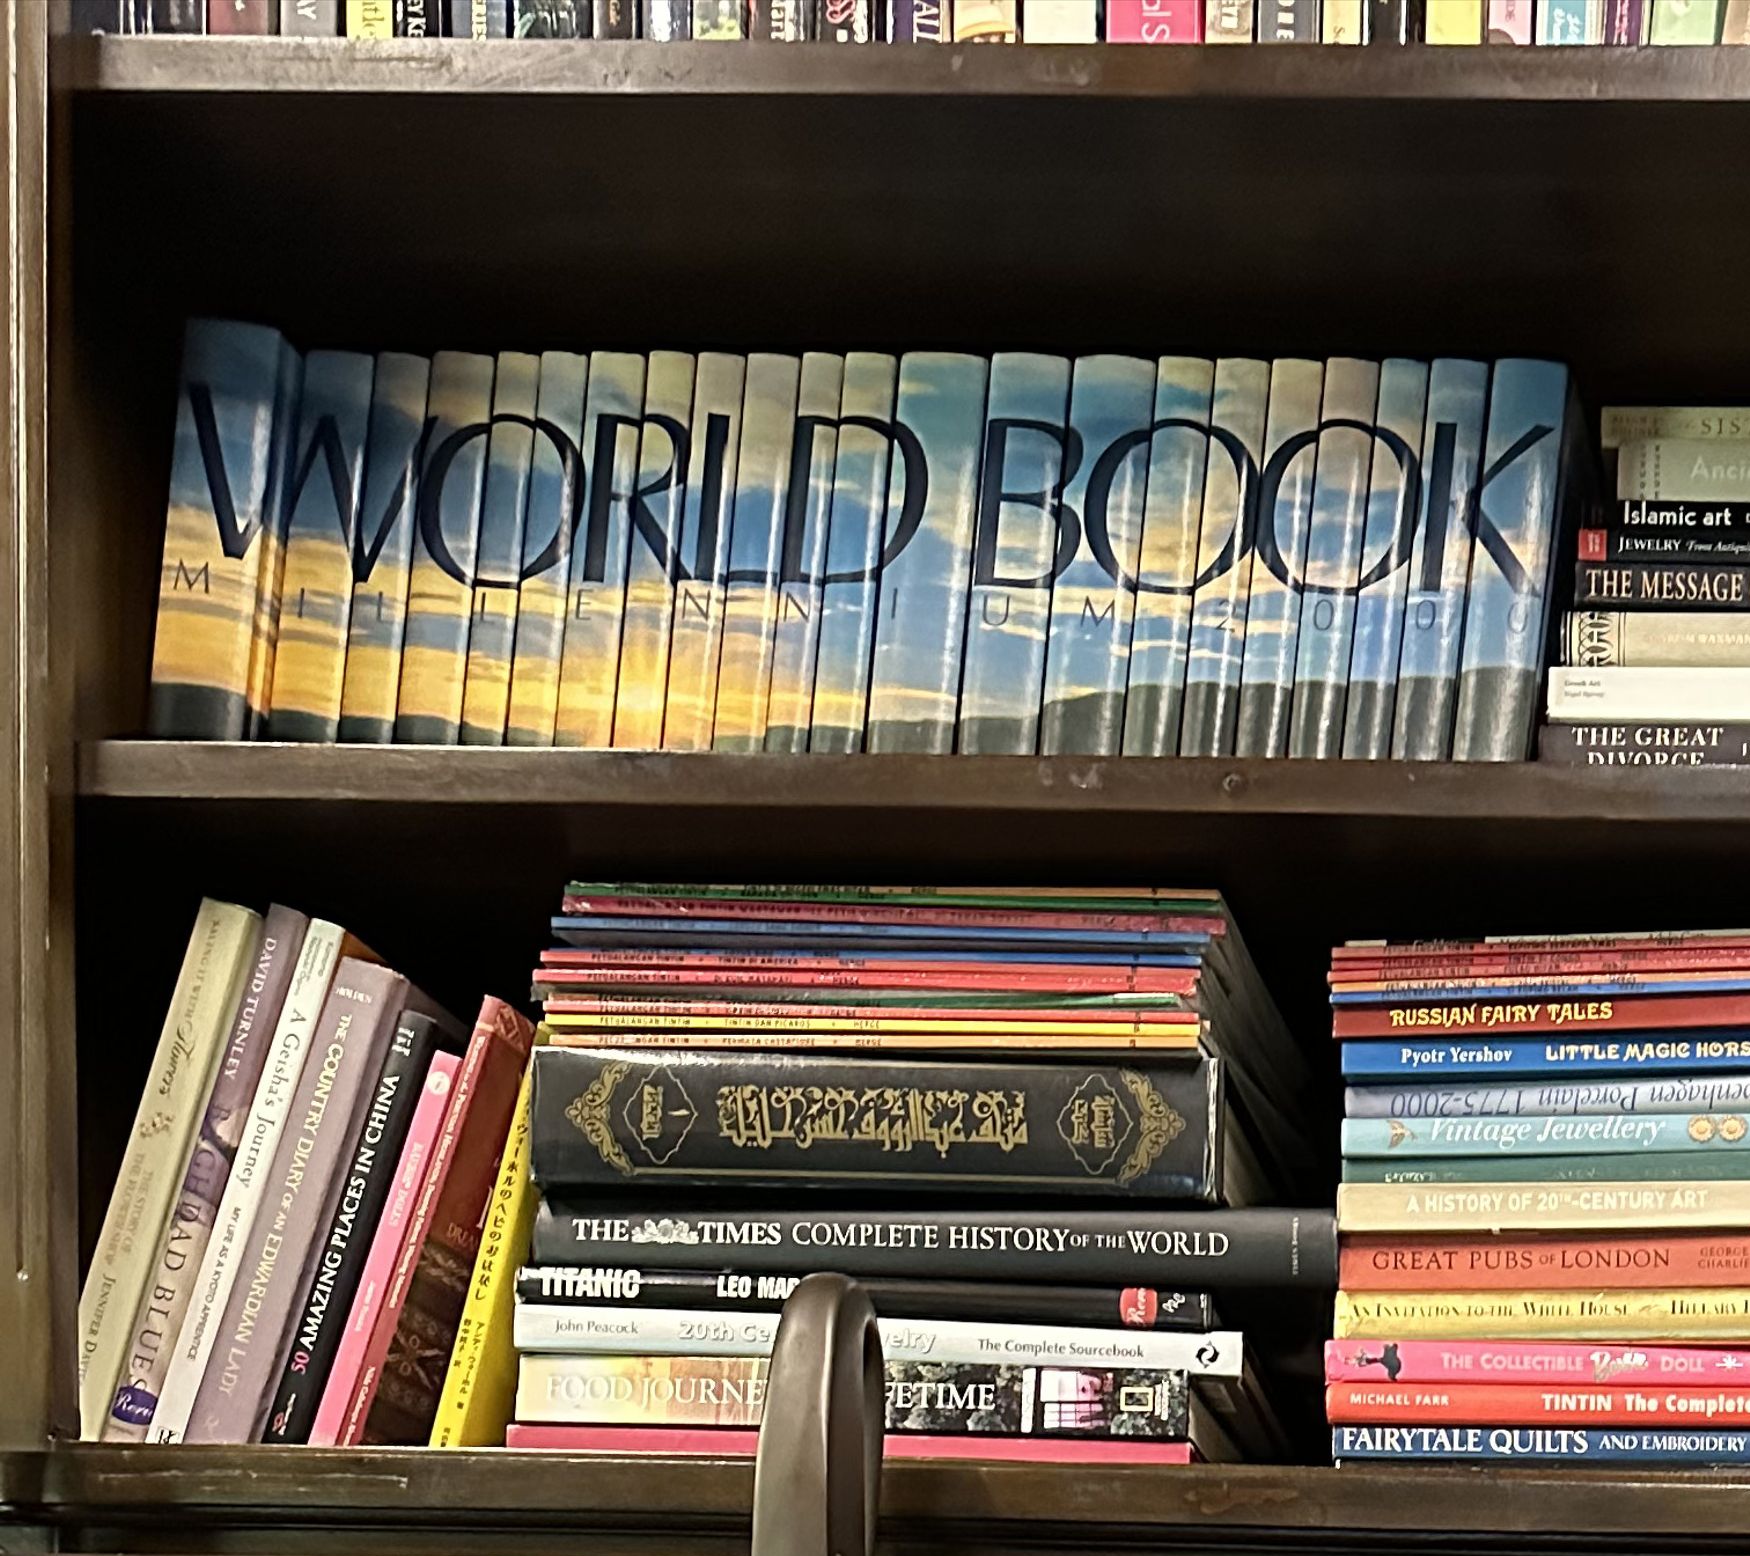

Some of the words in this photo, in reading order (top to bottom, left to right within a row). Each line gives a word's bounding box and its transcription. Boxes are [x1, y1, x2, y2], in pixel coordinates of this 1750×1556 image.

[190, 383, 929, 588] WORLD
[973, 416, 1555, 599] BOOK
[1624, 502, 1696, 527] Islamic
[1703, 508, 1731, 527] art
[1586, 569, 1633, 598] THE
[1641, 572, 1743, 602] MESSAGE
[1390, 1005, 1476, 1028] RUSSIAN
[1481, 1004, 1539, 1025] FAIRY
[1547, 1001, 1613, 1022] TALES
[363, 1073, 402, 1147] CHINA
[356, 1150, 372, 1173] IN
[330, 1176, 363, 1257] PLACES
[573, 1219, 629, 1243] THE
[698, 1219, 782, 1246] TIMES
[792, 1222, 939, 1250] COMPLETE
[949, 1225, 1070, 1253] HISTORY
[1095, 1234, 1126, 1250] THE
[1127, 1229, 1229, 1258] WORLD
[1372, 1250, 1459, 1271] GREAT
[1468, 1249, 1533, 1271] PUBS
[1561, 1248, 1670, 1270] LONDON
[541, 1268, 641, 1297] TITANIC
[302, 1256, 342, 1352] AMAZING
[555, 1318, 585, 1336] John
[589, 1319, 639, 1337] Peacock
[291, 1350, 310, 1375] 50
[1541, 1393, 1613, 1414] TINTIN
[1625, 1393, 1658, 1414] The
[1341, 1428, 1485, 1454] FAIRYTALE
[1490, 1430, 1589, 1455] QUILTS
[1599, 1434, 1637, 1451] AND
[1641, 1434, 1747, 1453] EMBROIDERY
